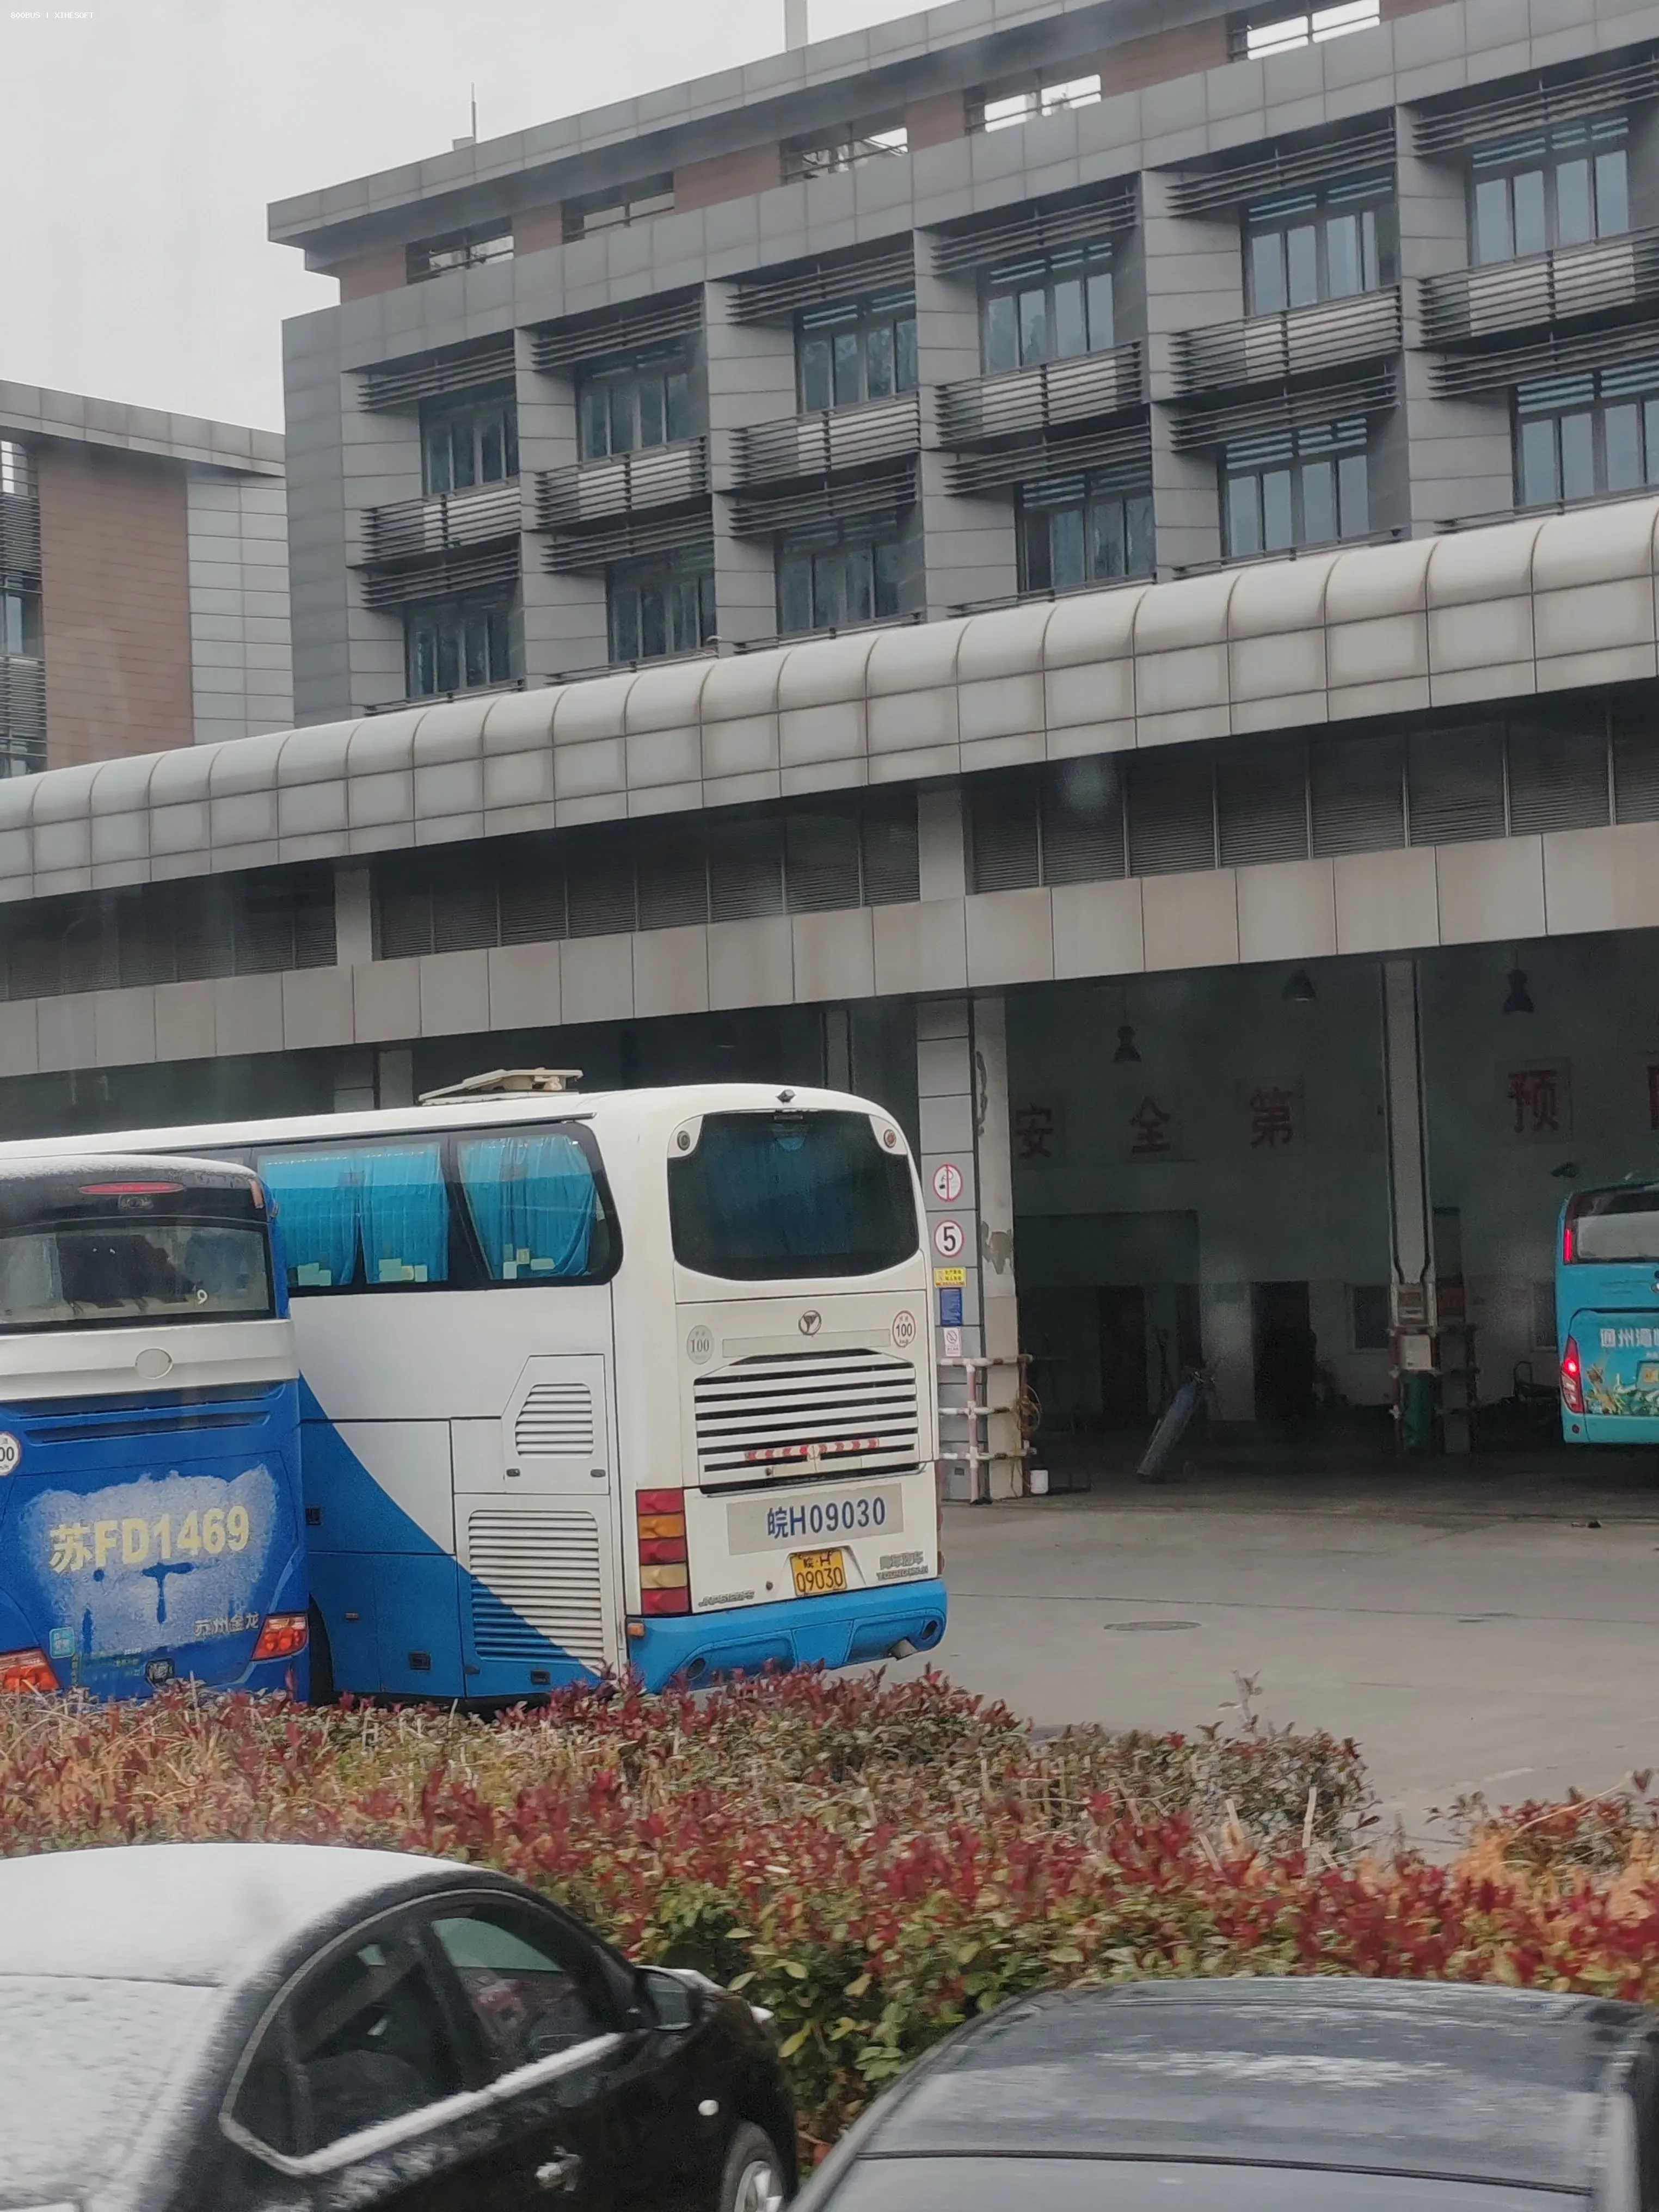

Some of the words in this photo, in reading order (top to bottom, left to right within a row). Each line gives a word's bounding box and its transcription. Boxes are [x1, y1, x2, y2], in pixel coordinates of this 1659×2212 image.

[943, 1226, 956, 1251] 5
[896, 1323, 912, 1337] 100
[691, 1338, 710, 1353] 100
[767, 1497, 886, 1540] 皖H09030
[49, 1505, 249, 1574] 苏FD1469
[796, 1566, 843, 1592] 09030
